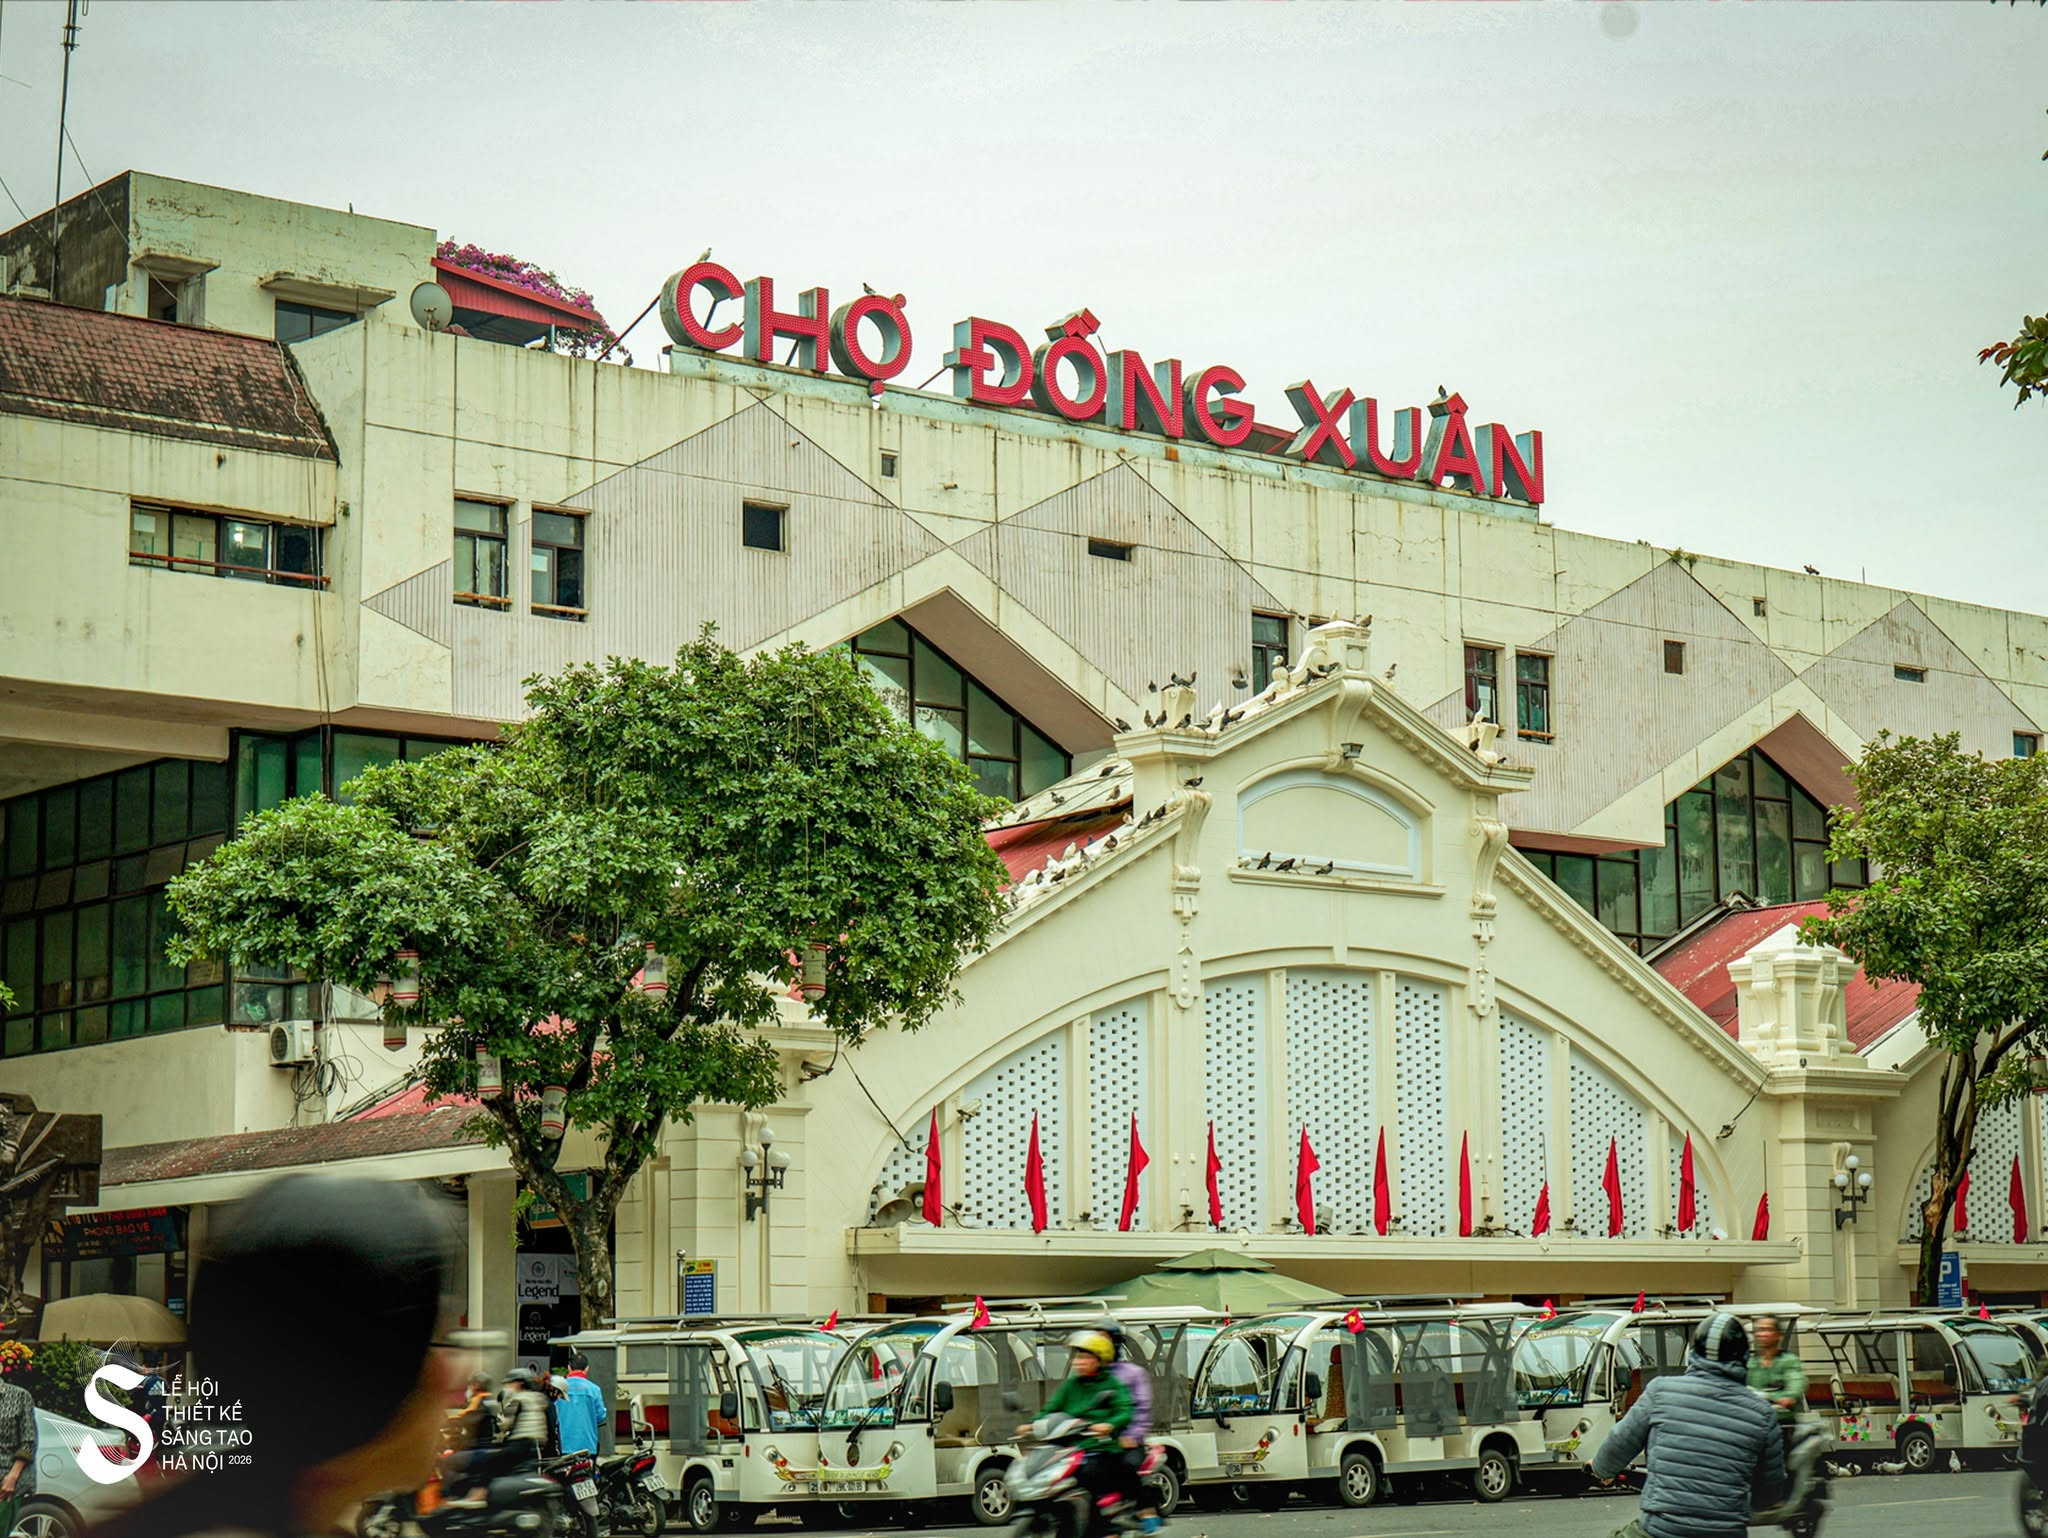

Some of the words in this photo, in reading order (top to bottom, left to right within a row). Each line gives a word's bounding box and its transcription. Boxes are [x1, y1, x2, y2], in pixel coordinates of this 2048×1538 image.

[662, 261, 913, 399] CHỢ
[943, 307, 1255, 447] ĐỒNG
[1284, 379, 1544, 505] XUÂN
[1939, 1261, 1952, 1283] P
[518, 1283, 560, 1299] Legend
[519, 1330, 551, 1344] Legend
